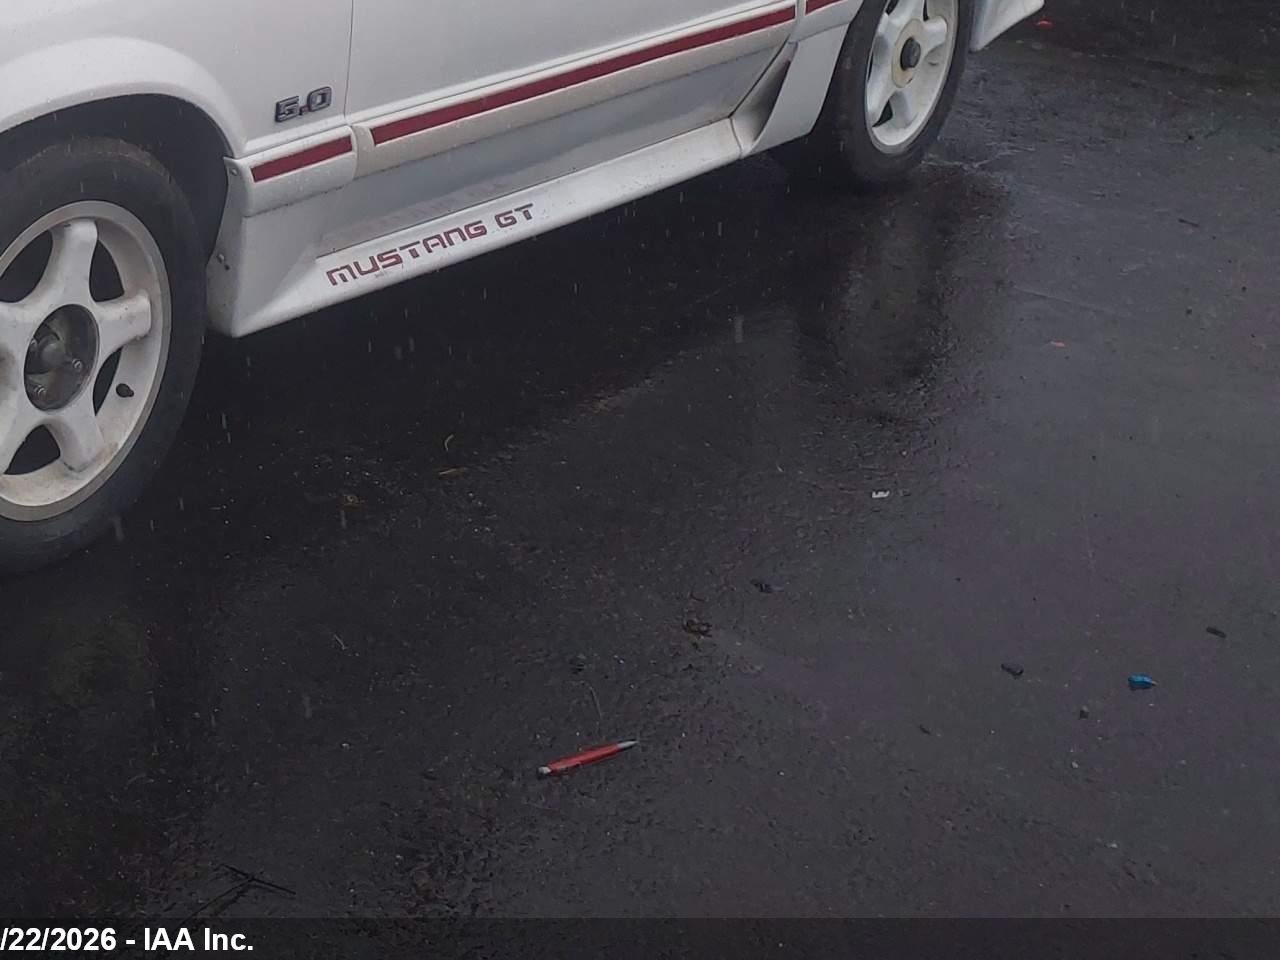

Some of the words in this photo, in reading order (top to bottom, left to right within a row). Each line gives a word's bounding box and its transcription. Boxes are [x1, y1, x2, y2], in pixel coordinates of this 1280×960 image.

[274, 86, 332, 123] 5.0
[326, 220, 488, 286] MUSTANG
[494, 203, 534, 230] GT
